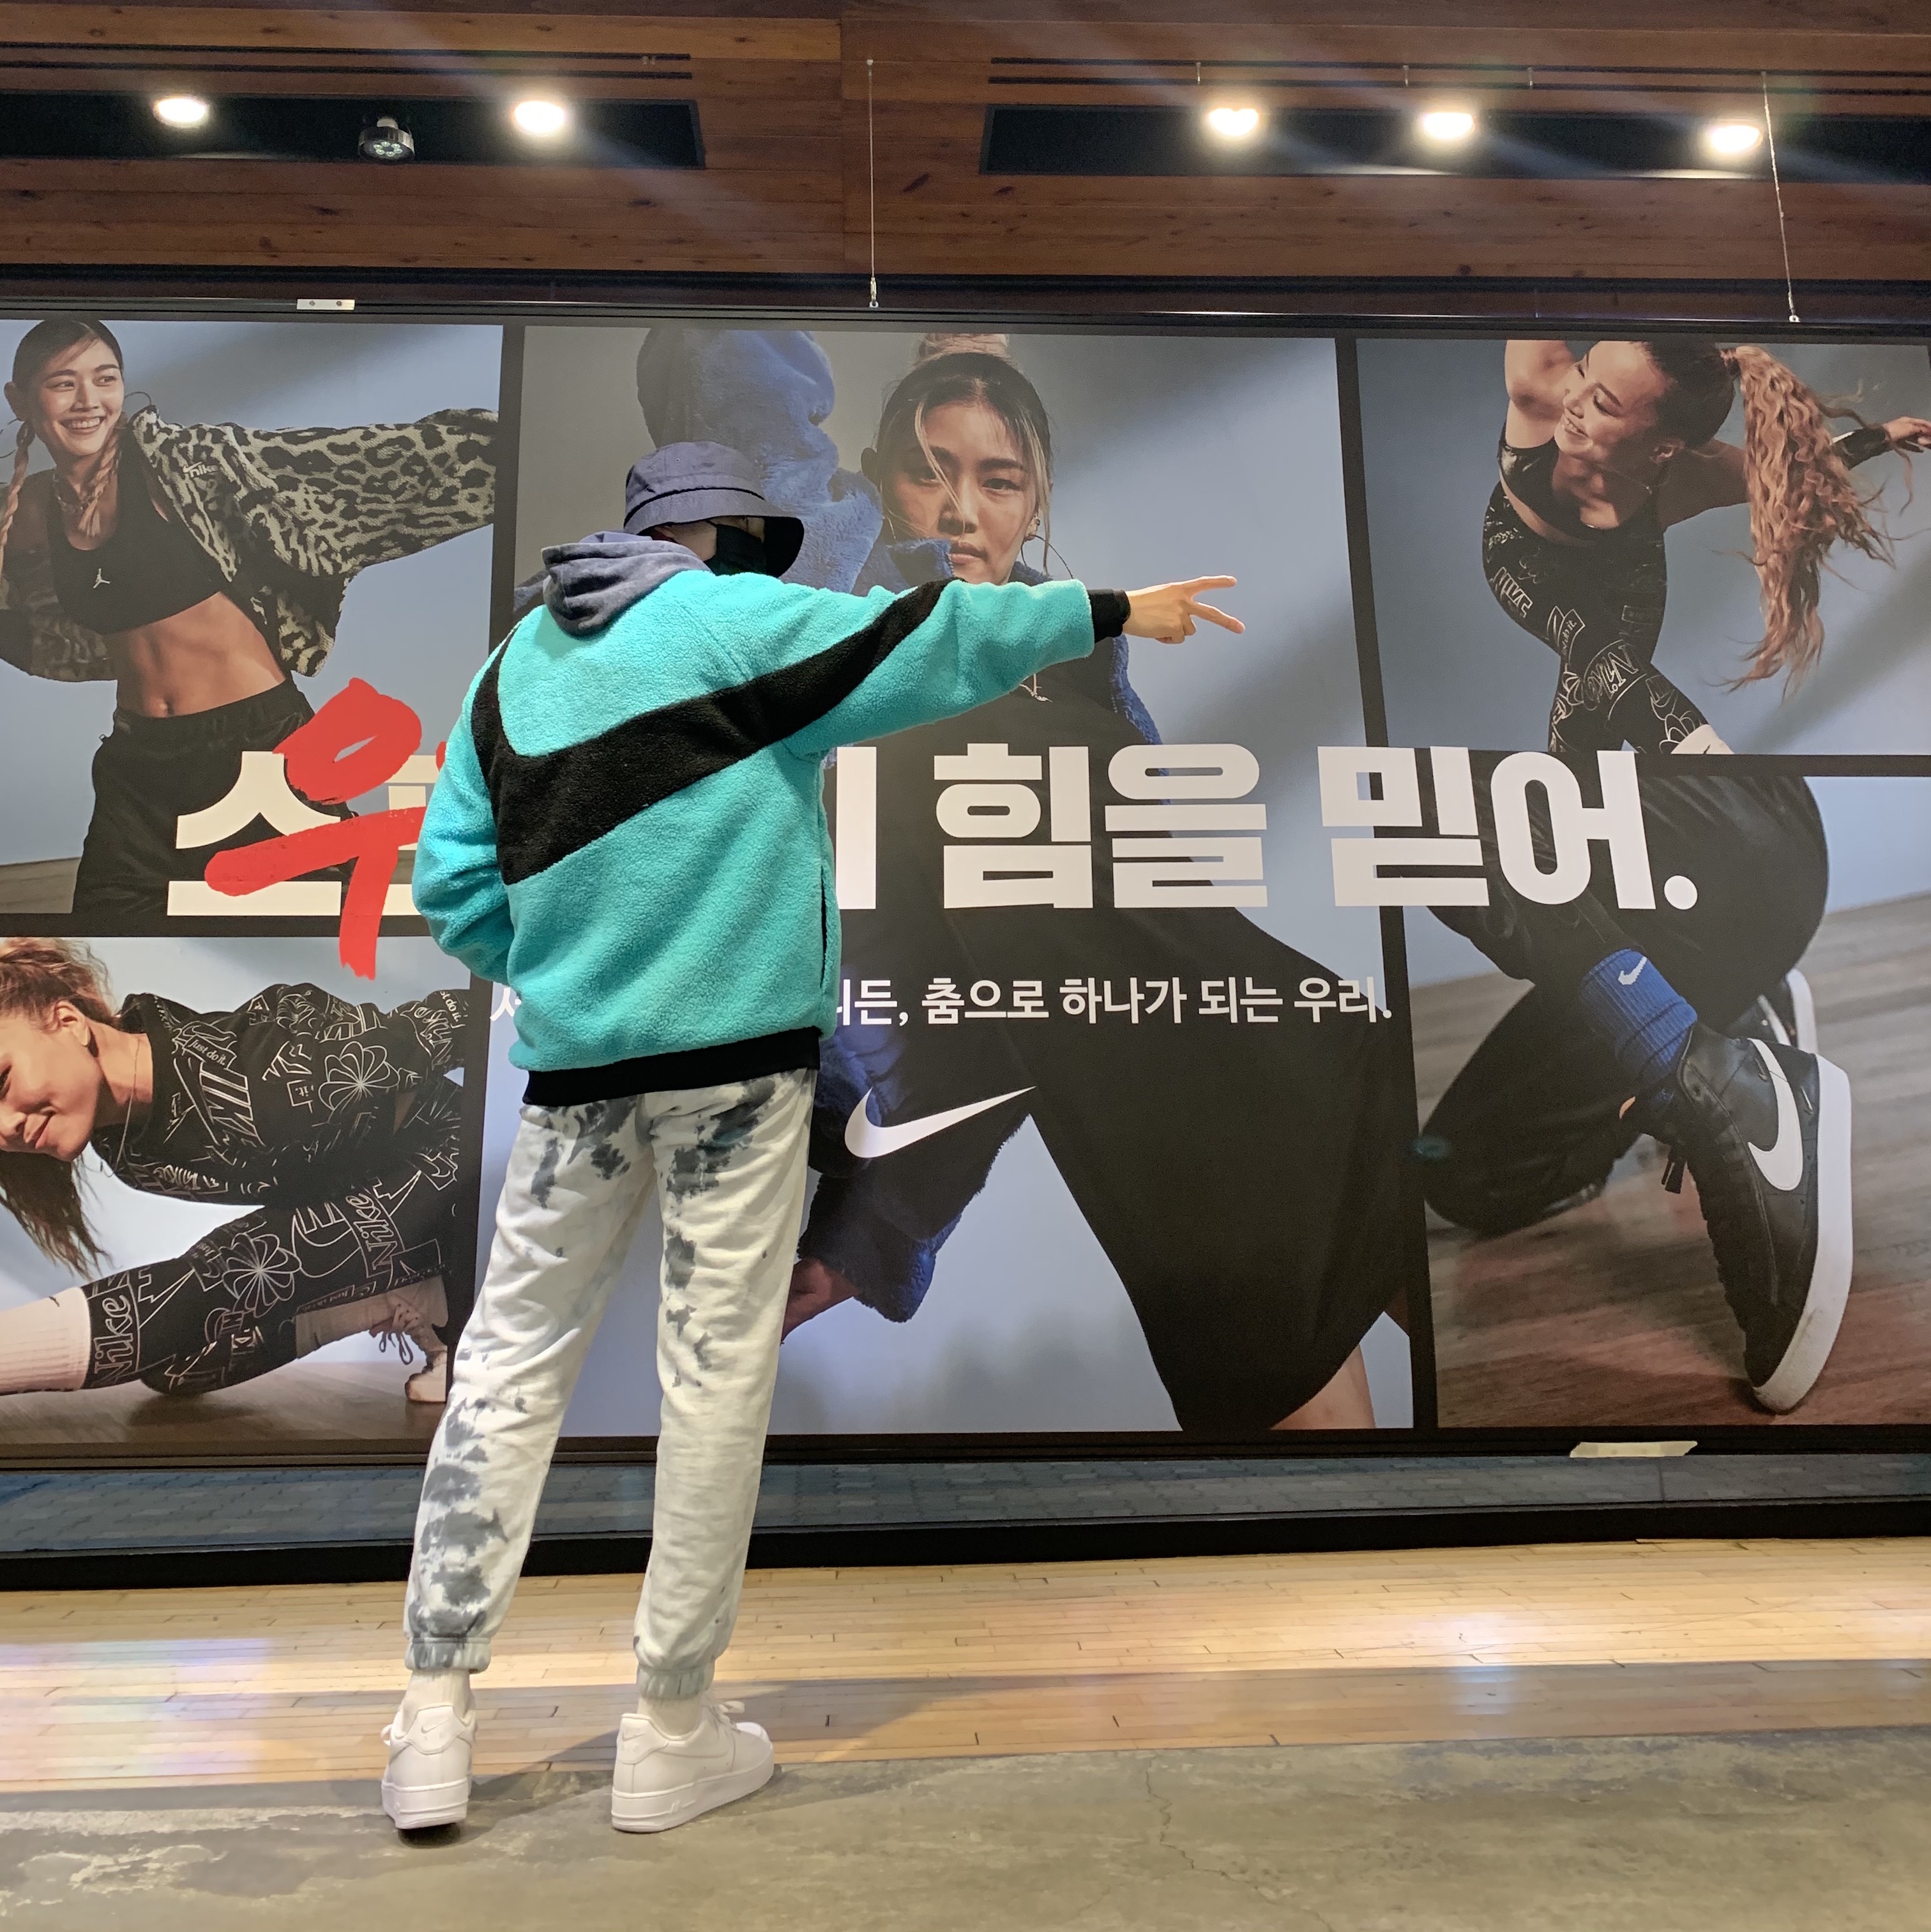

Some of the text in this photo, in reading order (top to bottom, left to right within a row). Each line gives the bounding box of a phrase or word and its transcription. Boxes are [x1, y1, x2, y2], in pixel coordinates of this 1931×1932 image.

[934, 743, 1268, 909] 힘을
[1317, 746, 1698, 909] 믿어.
[921, 978, 1049, 1024] 춤으로
[1059, 977, 1187, 1024] 하나가
[1198, 977, 1283, 1024] 되는
[1294, 977, 1392, 1023] 우리.
[187, 1039, 209, 1054] Just
[206, 1050, 219, 1061] do
[345, 1192, 395, 1270] Nike
[90, 1294, 134, 1388] Nike
